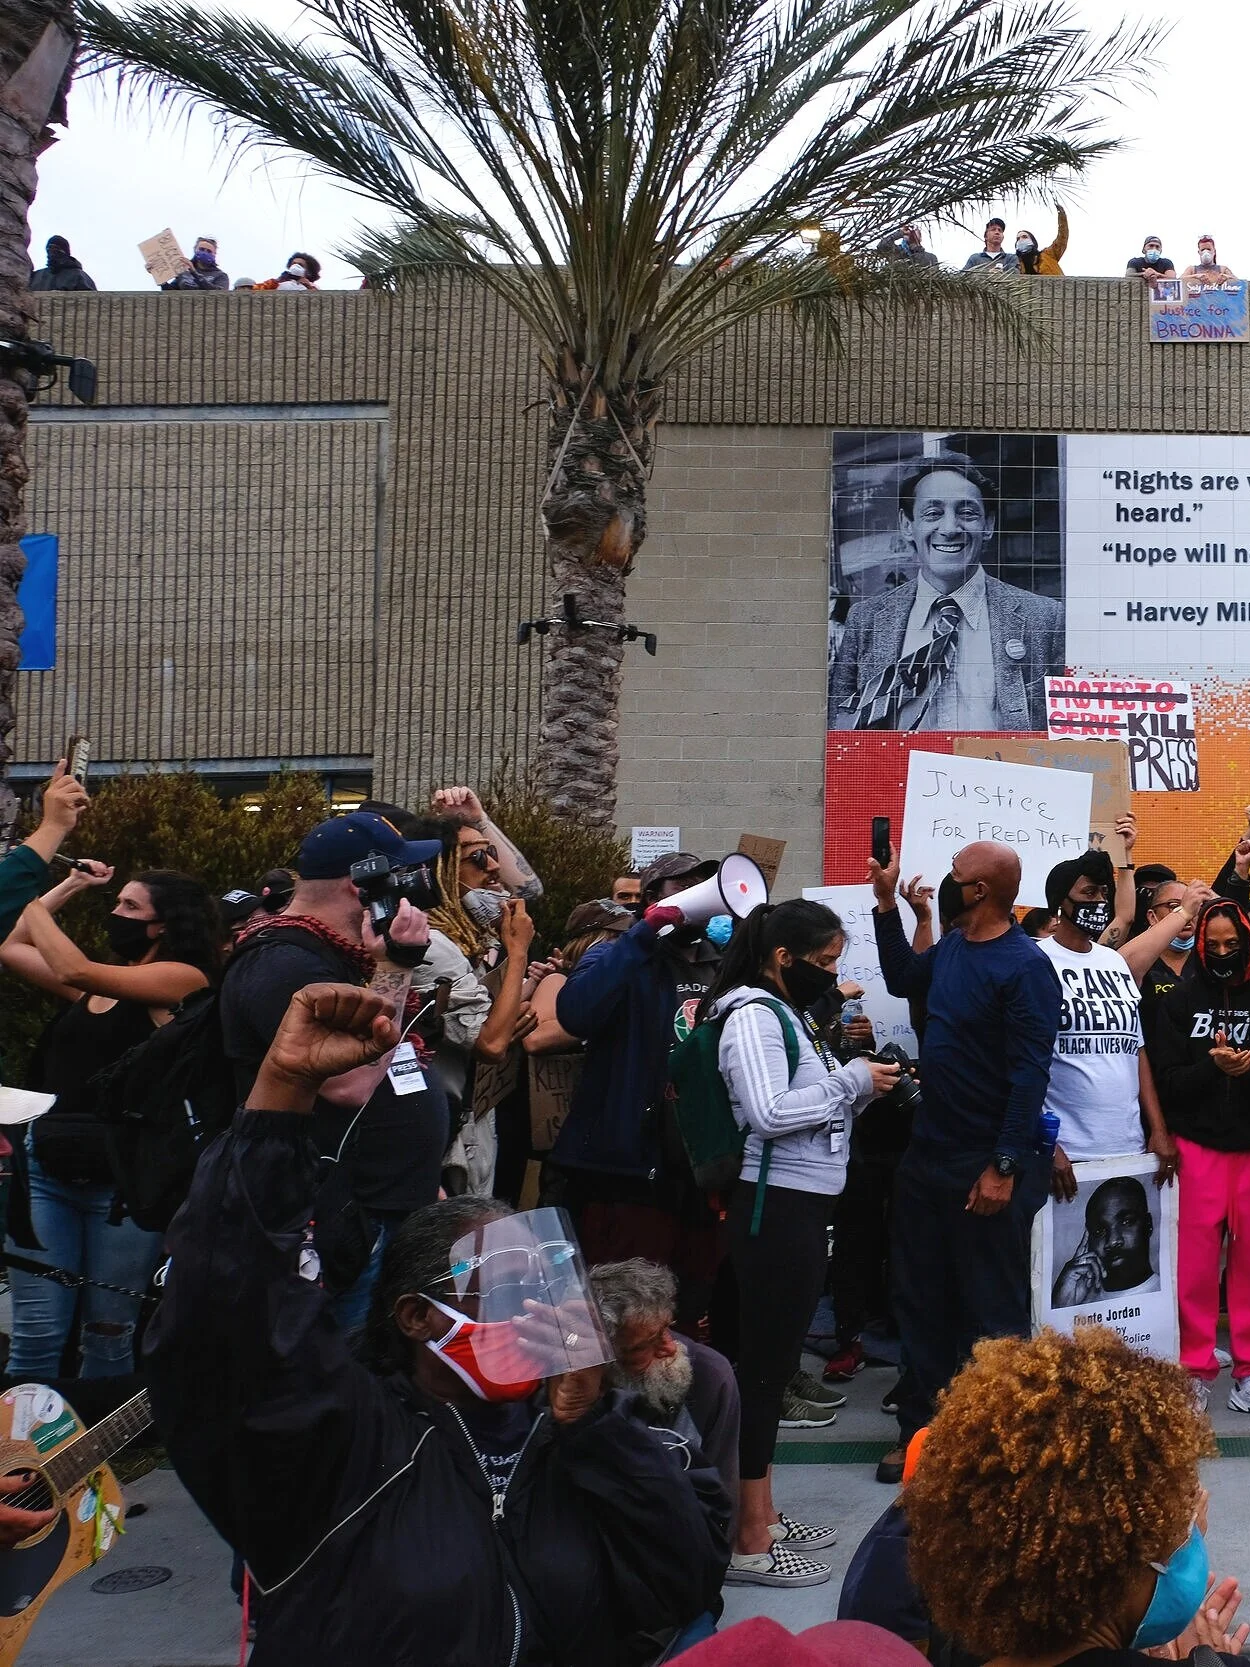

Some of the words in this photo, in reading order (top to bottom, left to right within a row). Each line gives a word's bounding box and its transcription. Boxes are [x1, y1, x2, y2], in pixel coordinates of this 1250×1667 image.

[1160, 304, 1201, 317] Justice
[1207, 304, 1230, 316] for
[1156, 320, 1236, 339] BREONNA
[1102, 470, 1193, 495] “Rights
[1200, 475, 1239, 491] are
[1116, 502, 1203, 523] heard.”
[1102, 542, 1177, 566] “Hope
[1184, 542, 1226, 563] will
[1126, 601, 1209, 626] Harvey
[1049, 680, 1152, 712] PROTECT
[1049, 711, 1121, 736] SERVE
[1127, 712, 1195, 739] KILL
[922, 770, 1055, 821] Justice
[932, 819, 966, 840] FOR
[978, 821, 1030, 844] FRED
[1036, 829, 1090, 851] TAFT
[852, 933, 878, 946] OR
[676, 983, 710, 993] SADE
[1061, 968, 1139, 999] CAN'T
[1057, 998, 1139, 1033] BREATH
[1058, 1037, 1092, 1054] BLACK
[1095, 1037, 1120, 1054] LIVES
[393, 1061, 418, 1072] PRESS
[1106, 1305, 1141, 1322] Jordan
